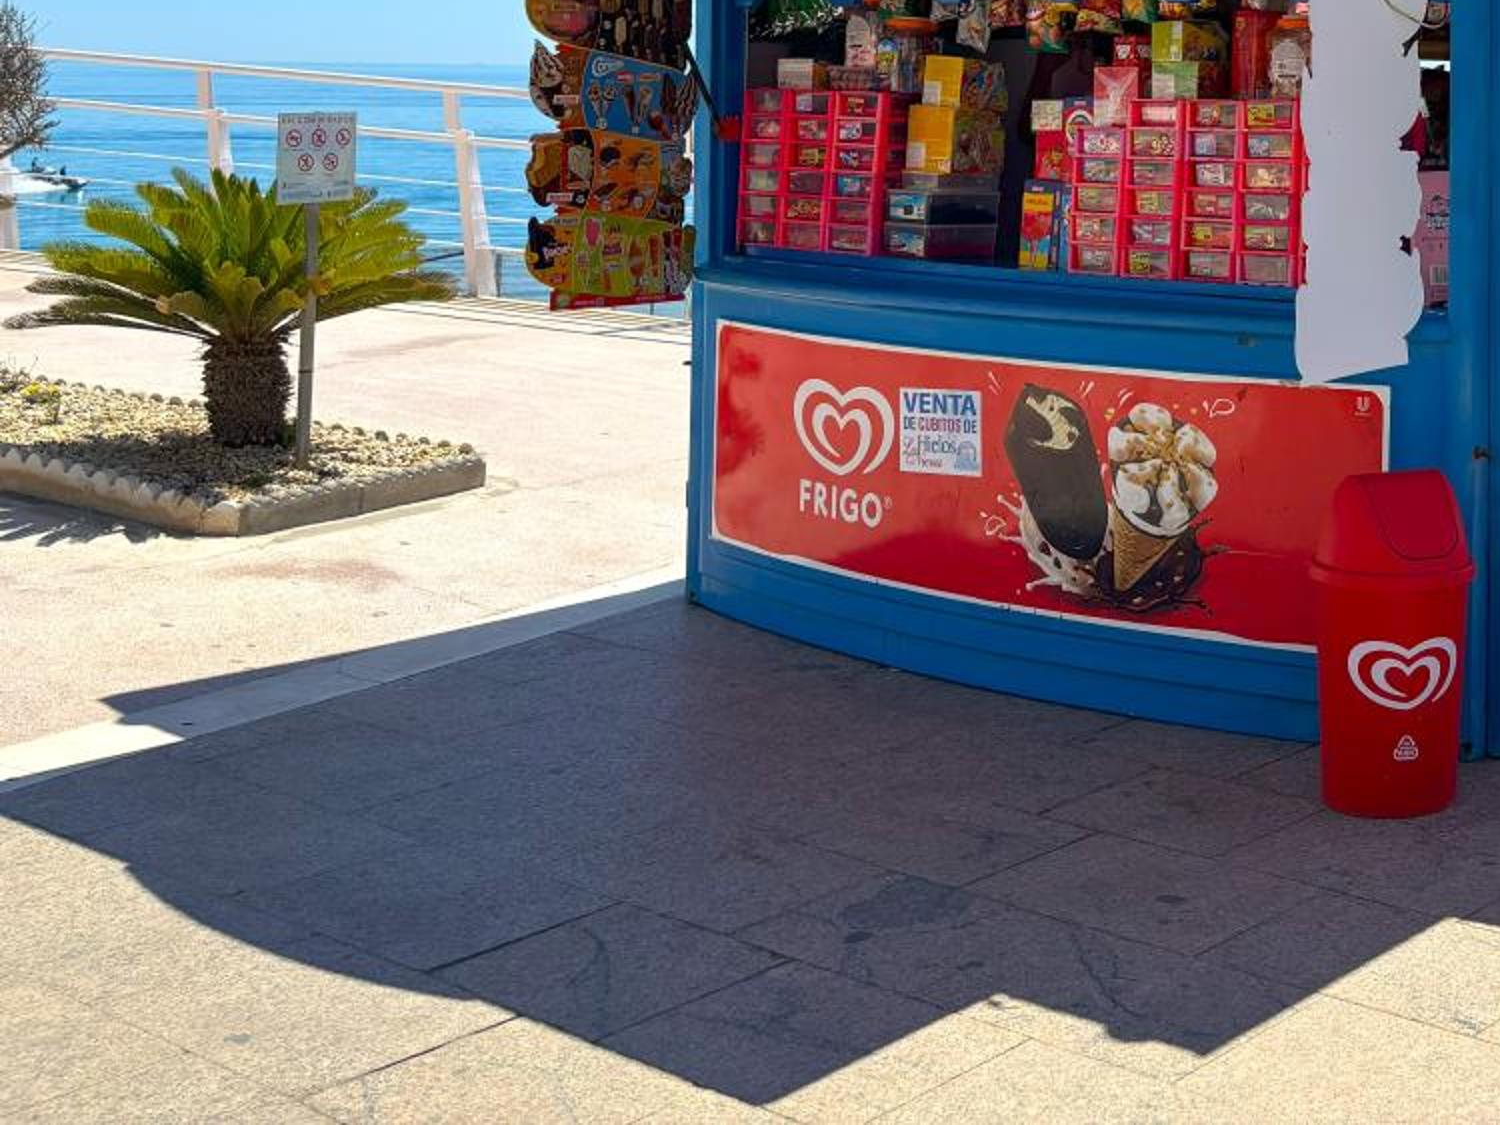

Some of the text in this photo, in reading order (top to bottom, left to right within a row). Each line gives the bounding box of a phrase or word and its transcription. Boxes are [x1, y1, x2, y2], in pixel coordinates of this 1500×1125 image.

[903, 392, 977, 416] VENTA
[903, 416, 977, 434] DE CUBITOS DE
[800, 478, 883, 529] FRIGO
